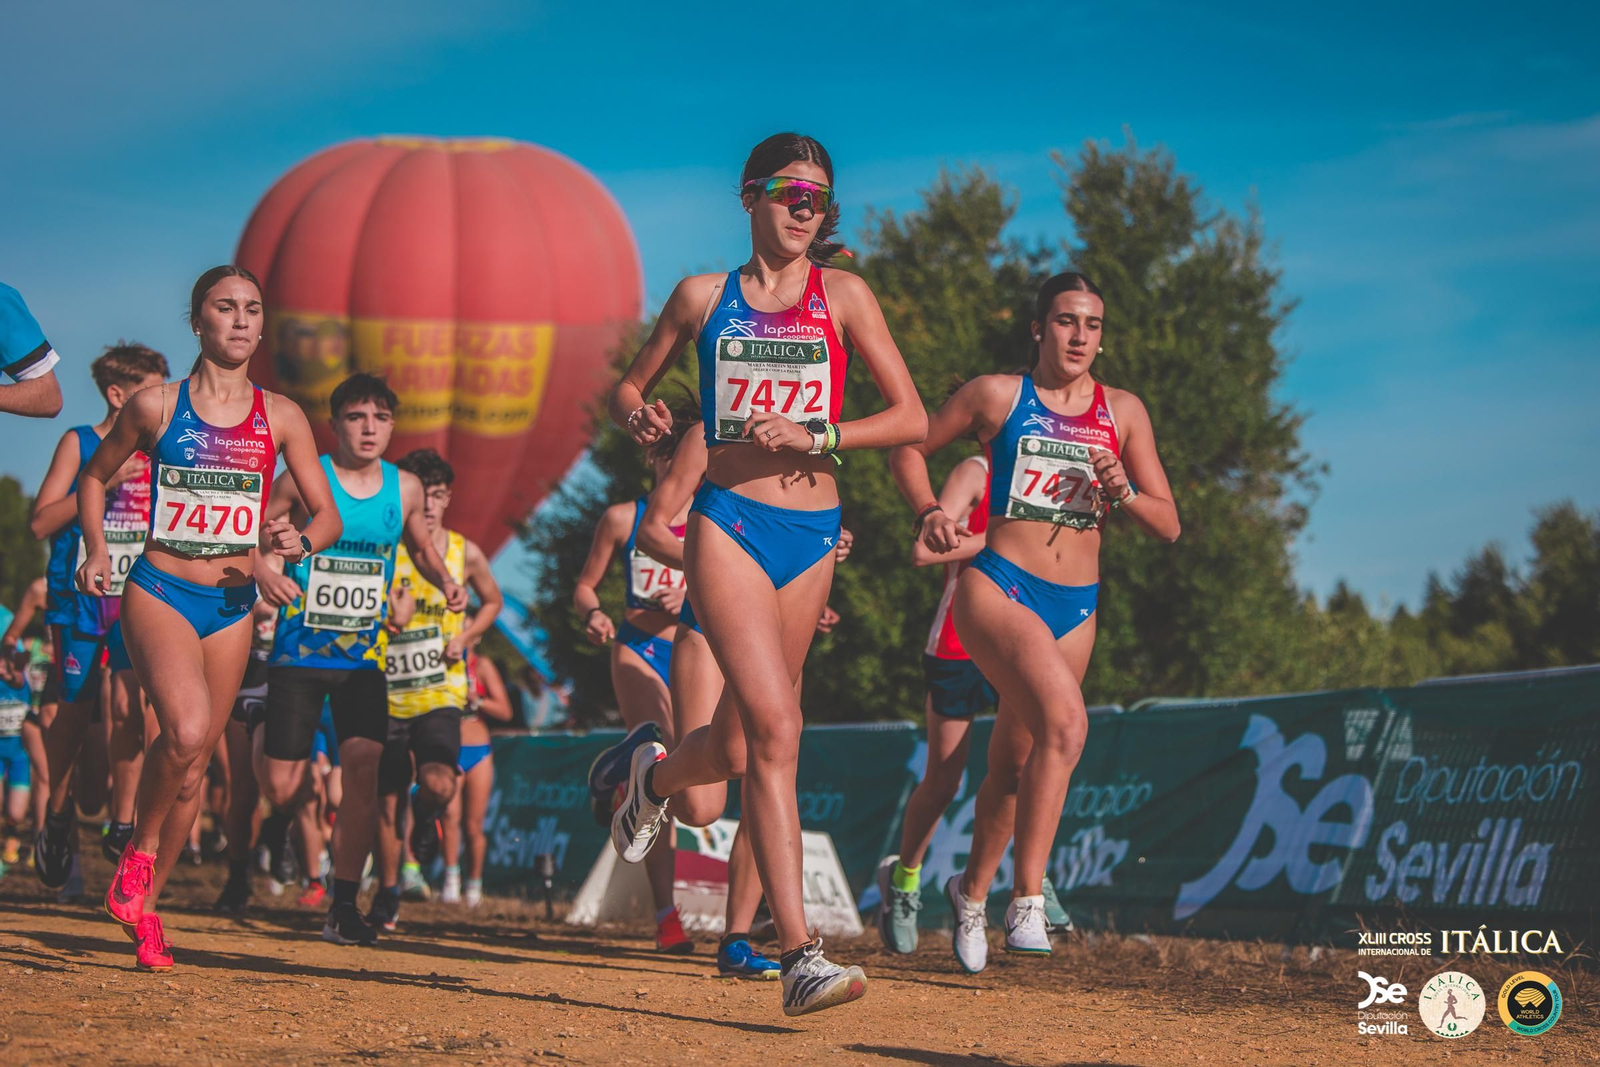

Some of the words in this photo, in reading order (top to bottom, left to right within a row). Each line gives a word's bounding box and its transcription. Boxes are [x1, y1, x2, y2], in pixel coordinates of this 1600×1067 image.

[764, 321, 825, 337] lapalma
[750, 342, 806, 357] ITÁLICA
[727, 377, 824, 414] 7472
[1060, 422, 1110, 439] lapalma
[215, 436, 265, 449] lapalma
[1046, 442, 1089, 458] ITÁLICA
[187, 471, 235, 485] ITÁLICA
[166, 501, 254, 537] 7470
[316, 584, 378, 611] 6005
[385, 649, 441, 676] 8108
[1395, 748, 1582, 816] Diputación
[1366, 817, 1555, 906] Sevilla
